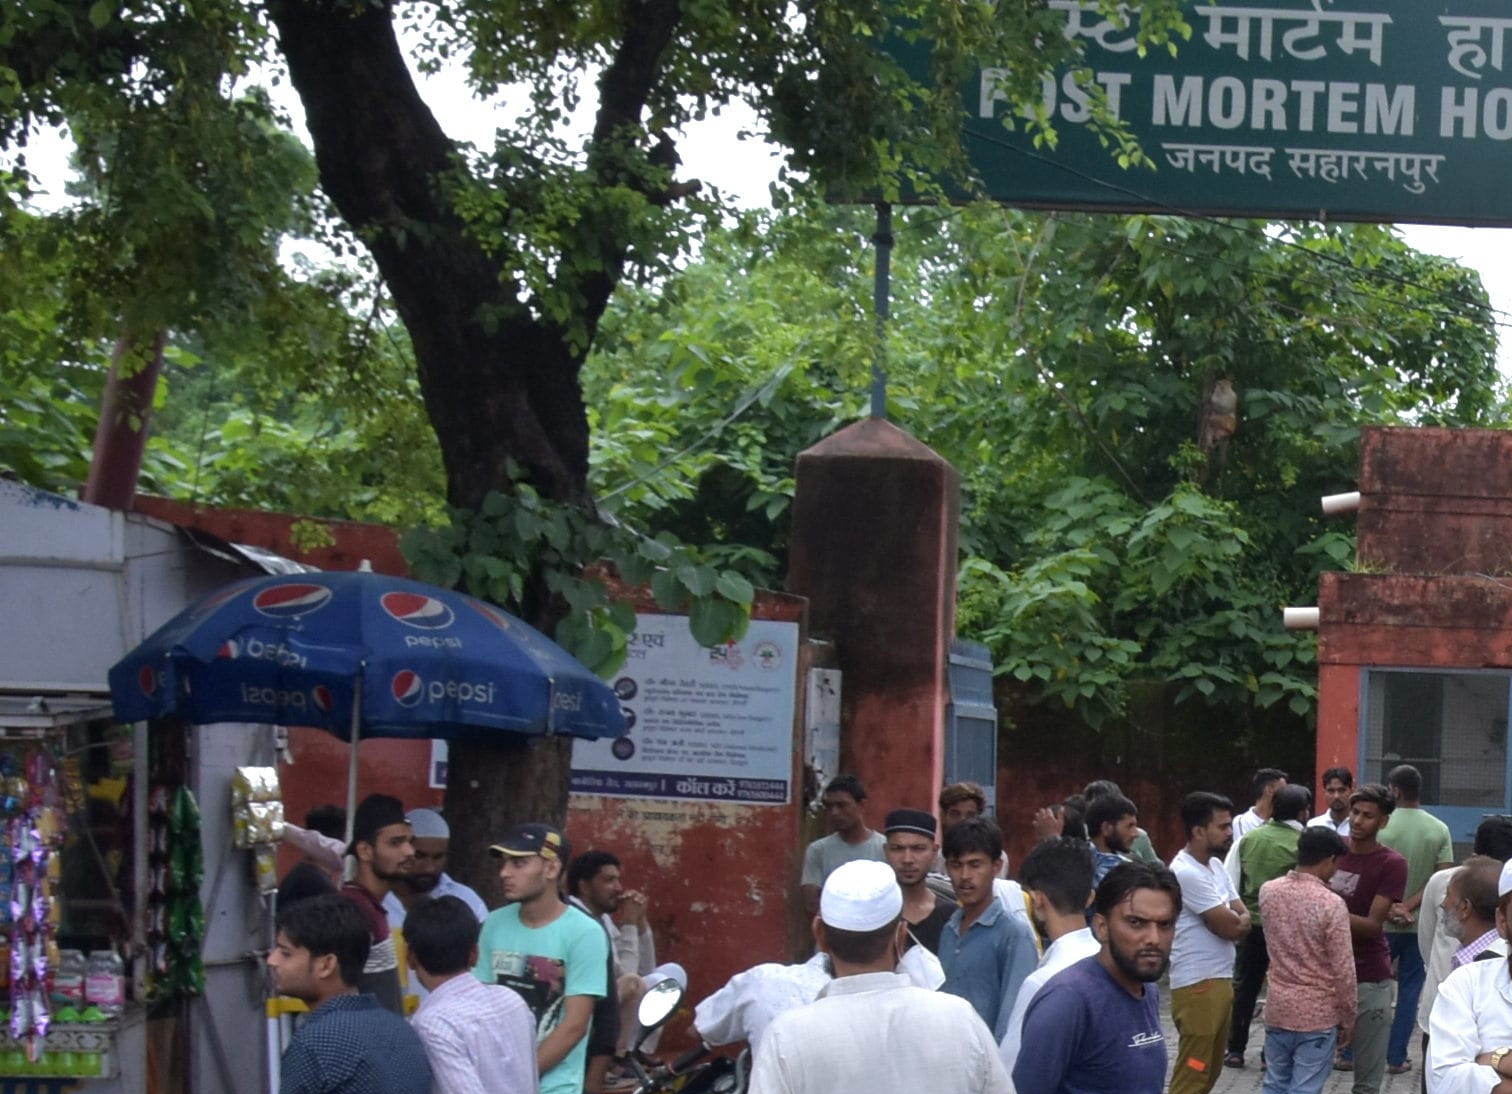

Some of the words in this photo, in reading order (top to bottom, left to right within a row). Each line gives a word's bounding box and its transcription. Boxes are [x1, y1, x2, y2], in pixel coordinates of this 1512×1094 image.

[1152, 74, 1415, 136] MORTEM
[1161, 143, 1276, 181] जनपद
[1284, 148, 1446, 194] सहारनपुर
[404, 634, 462, 649] pepsi
[428, 681, 495, 704] pepsi
